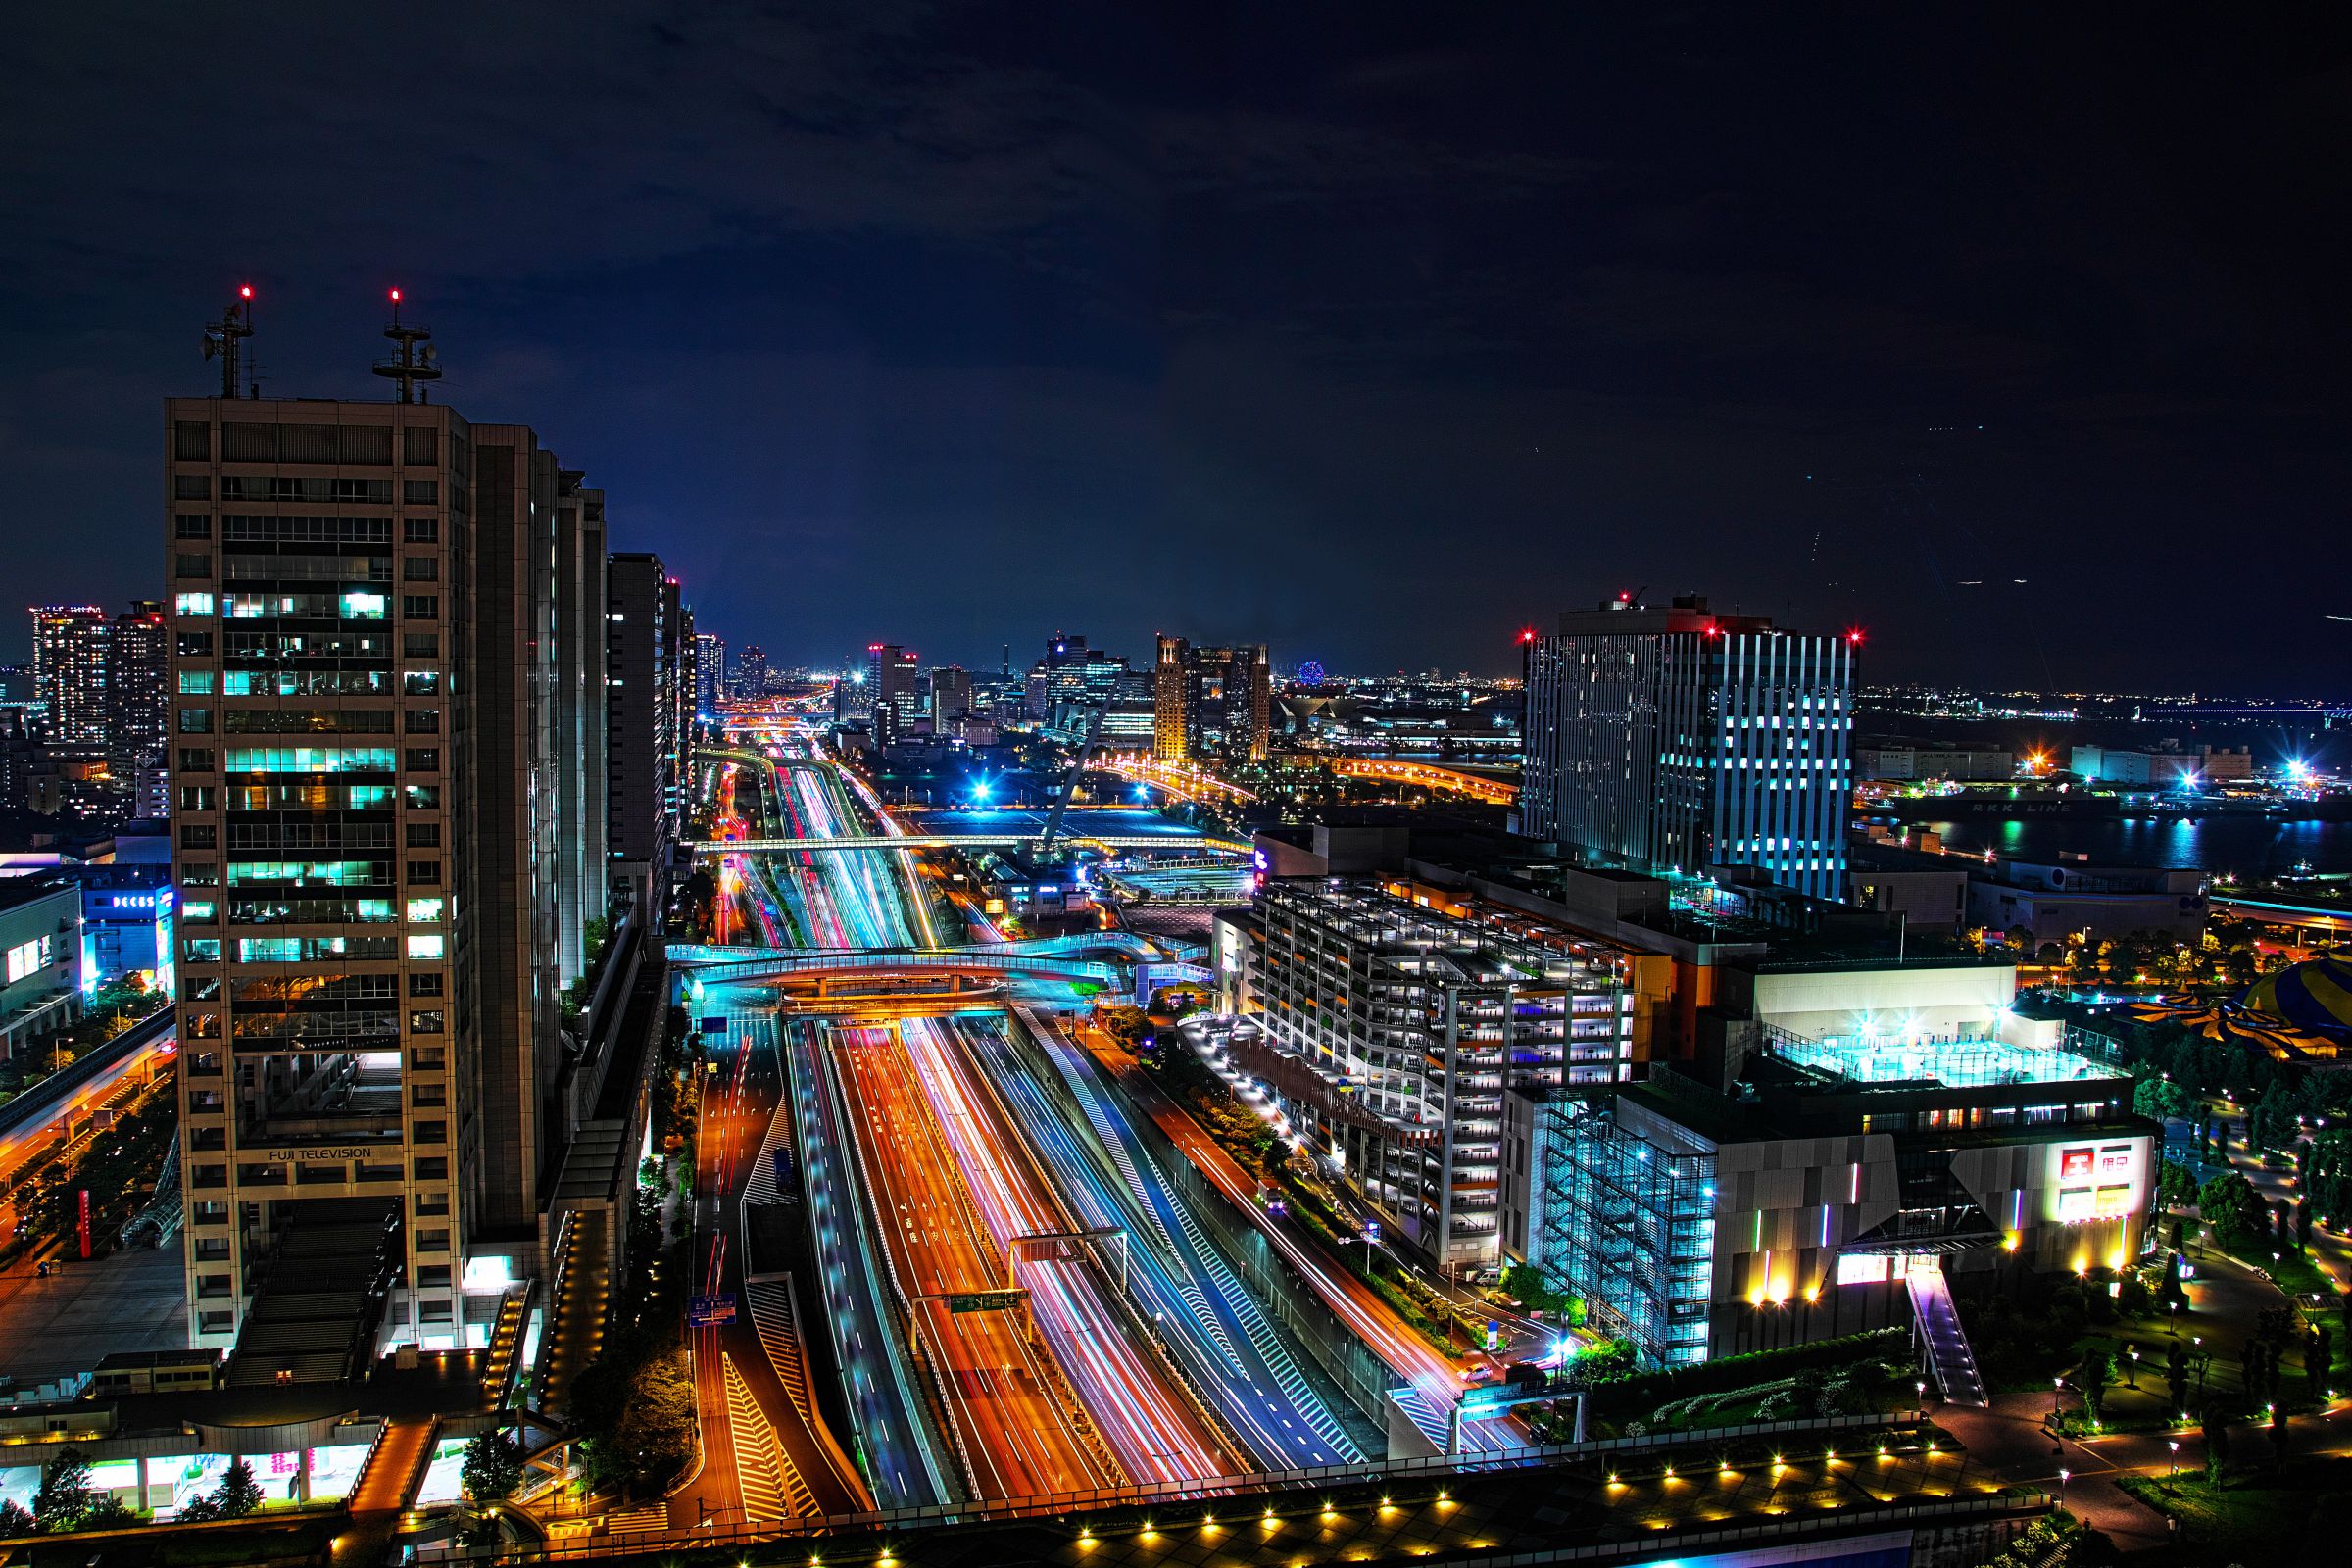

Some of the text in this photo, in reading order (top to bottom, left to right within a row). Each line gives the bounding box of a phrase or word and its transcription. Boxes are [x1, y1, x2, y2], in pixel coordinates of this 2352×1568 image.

[1972, 804, 2071, 812] RKK LINE
[113, 896, 155, 907] DECKS
[270, 1148, 371, 1160] FUJI TELEVISION
